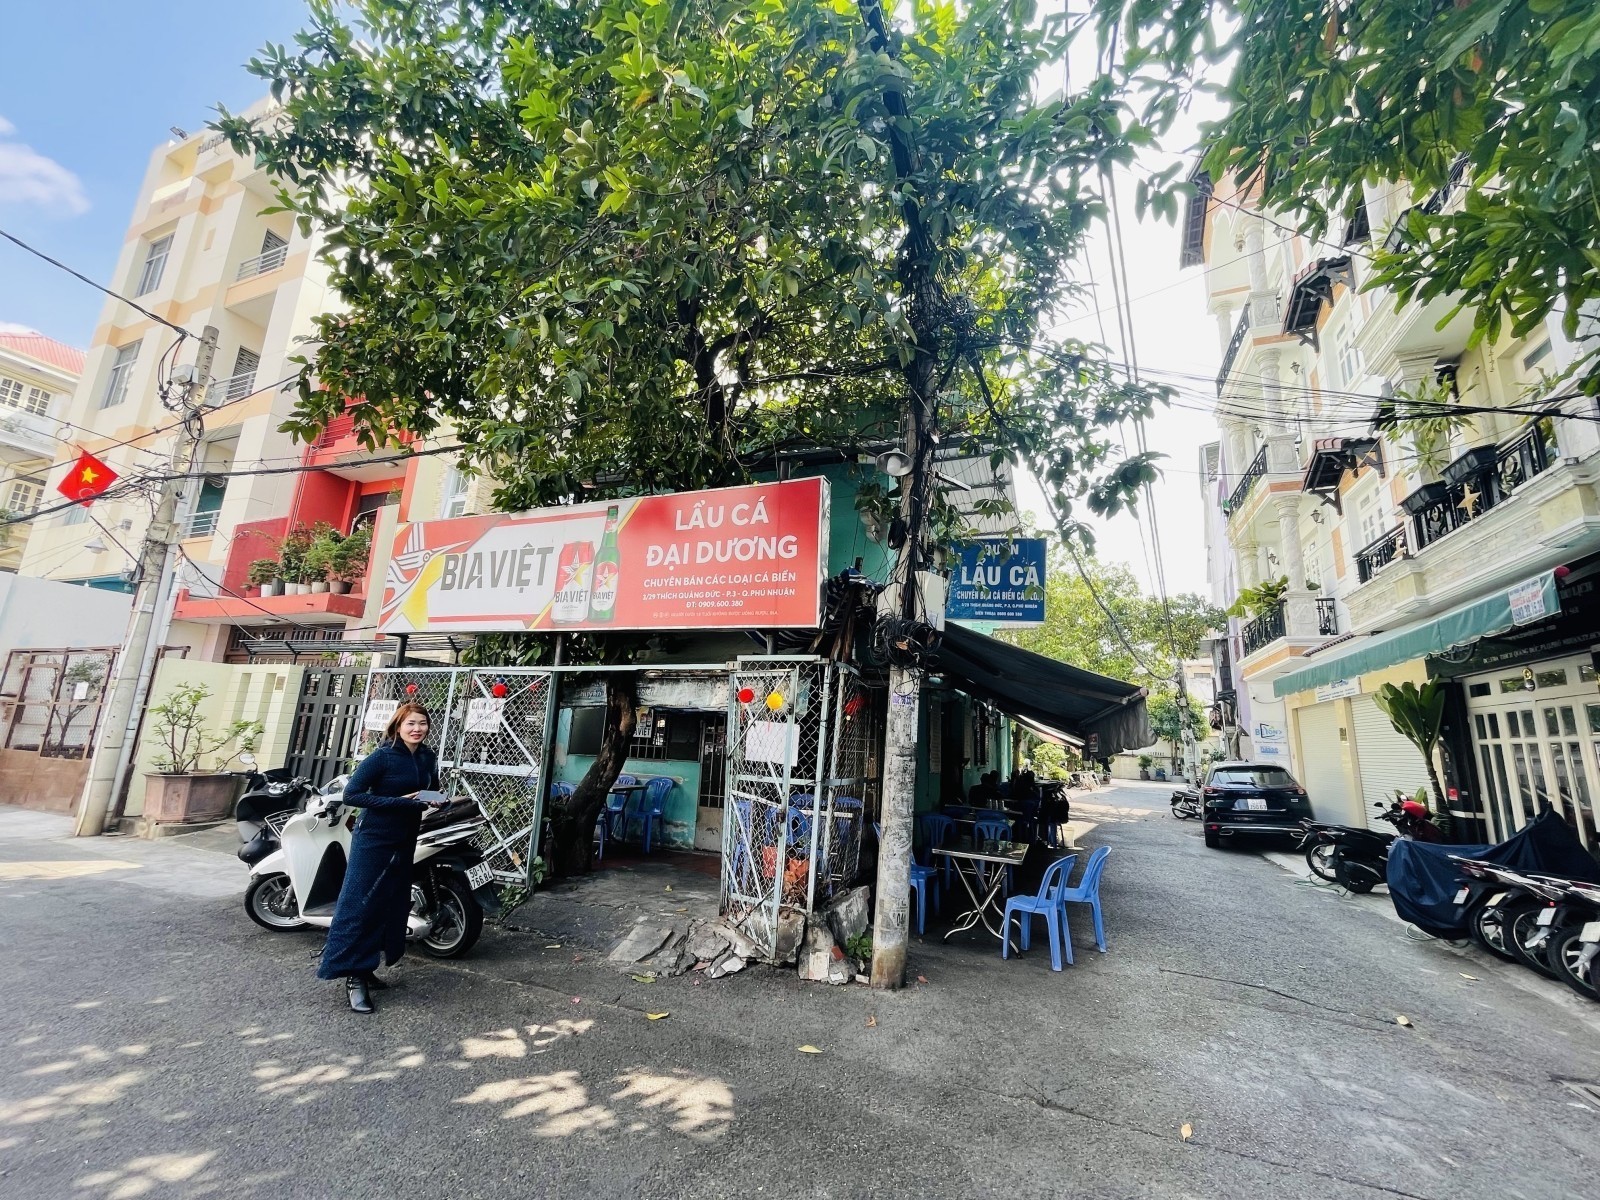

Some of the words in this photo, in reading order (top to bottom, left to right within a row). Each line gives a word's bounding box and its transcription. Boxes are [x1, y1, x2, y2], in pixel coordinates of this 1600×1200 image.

[674, 500, 724, 530] LẨU
[731, 495, 770, 526] CÁ
[646, 542, 690, 571] ĐẠI
[696, 535, 798, 564] DƯƠNG
[984, 544, 1020, 556] QUN
[644, 575, 682, 588] CHUYÊN
[684, 574, 704, 586] BÁN
[705, 573, 726, 585] CÁC
[728, 574, 752, 586] LOẠI
[754, 571, 770, 583] CÁ
[772, 570, 796, 582] BIỂN
[961, 558, 1001, 586] LẨU
[1009, 561, 1040, 586] CÁ
[656, 592, 678, 600] THÍCH
[680, 590, 703, 600] QUẢNG
[705, 589, 720, 598] ĐỨC
[768, 588, 796, 597] NHUẬN
[956, 589, 978, 600] CHUYÊN
[993, 590, 1000, 600] CÁ
[1002, 588, 1015, 600] BIỂN
[698, 600, 744, 608] 0909.600.380
